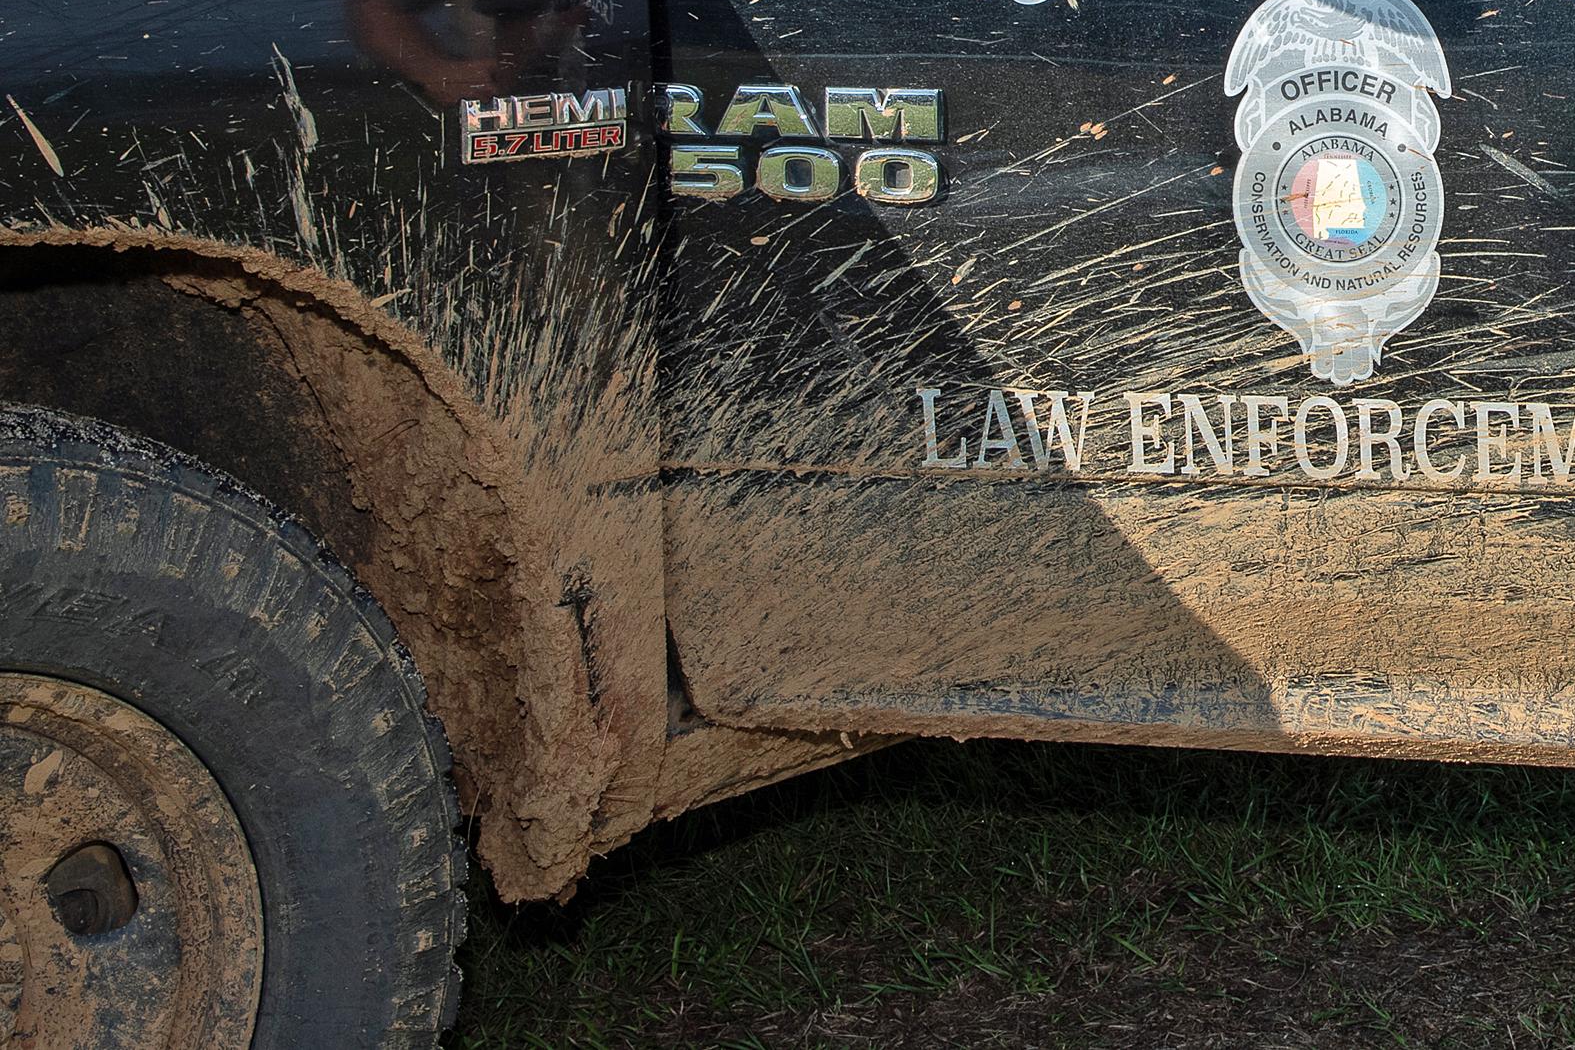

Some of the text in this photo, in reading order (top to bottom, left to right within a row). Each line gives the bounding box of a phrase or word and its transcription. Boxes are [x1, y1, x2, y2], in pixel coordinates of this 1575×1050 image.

[1281, 70, 1397, 104] OFFICER
[462, 88, 627, 131] HEMI
[654, 83, 945, 141] RAM
[1289, 107, 1389, 137] ALABAMA
[474, 127, 621, 156] 5.7 LITER
[1302, 138, 1375, 162] ALABAMA
[1251, 171, 1427, 291] CONSERVATION AND NATURAL RESOURCES
[1295, 233, 1385, 259] GREAT SEAL
[916, 388, 1095, 472] LAW
